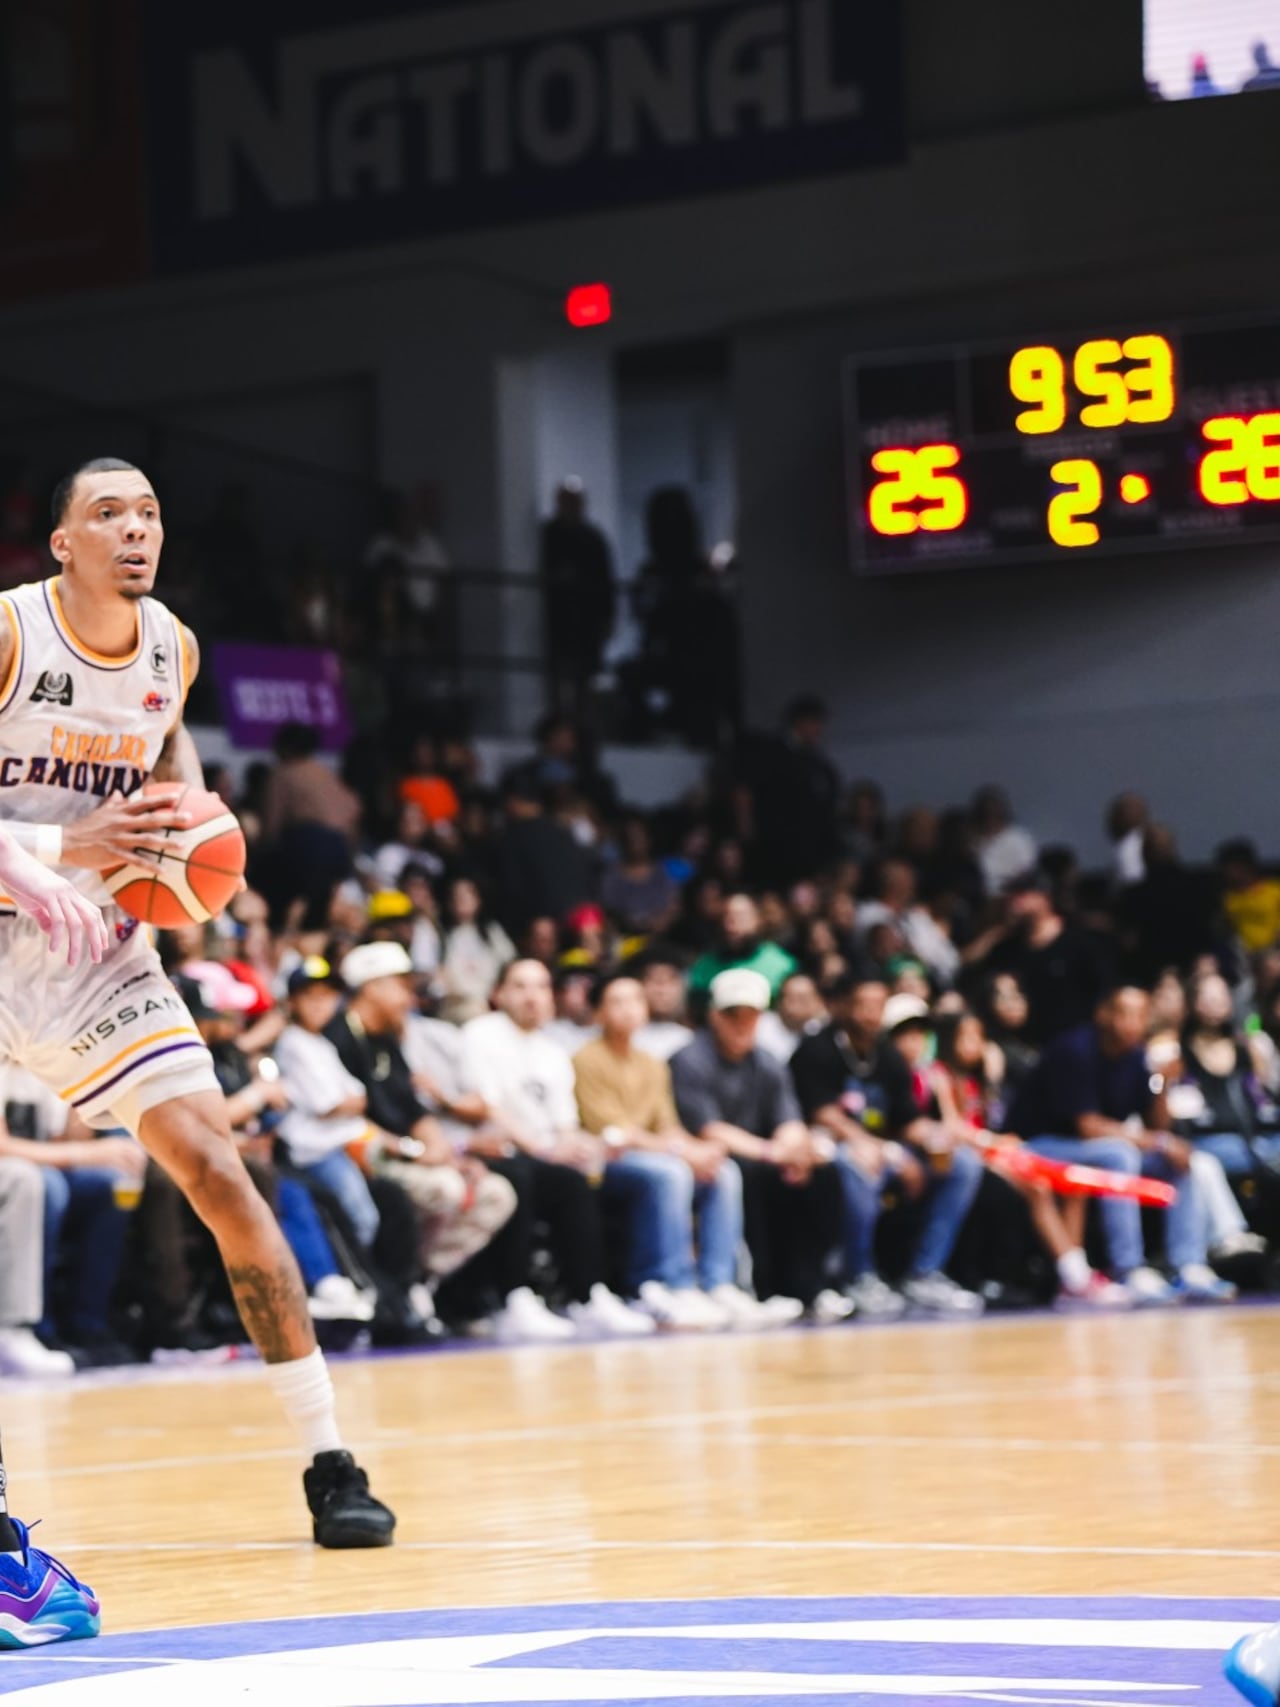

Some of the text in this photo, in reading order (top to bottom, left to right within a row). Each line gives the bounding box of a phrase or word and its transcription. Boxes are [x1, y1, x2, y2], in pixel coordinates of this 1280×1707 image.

[187, 0, 865, 220] NATIONAL
[869, 445, 968, 536] 25
[1047, 459, 1103, 548] 2
